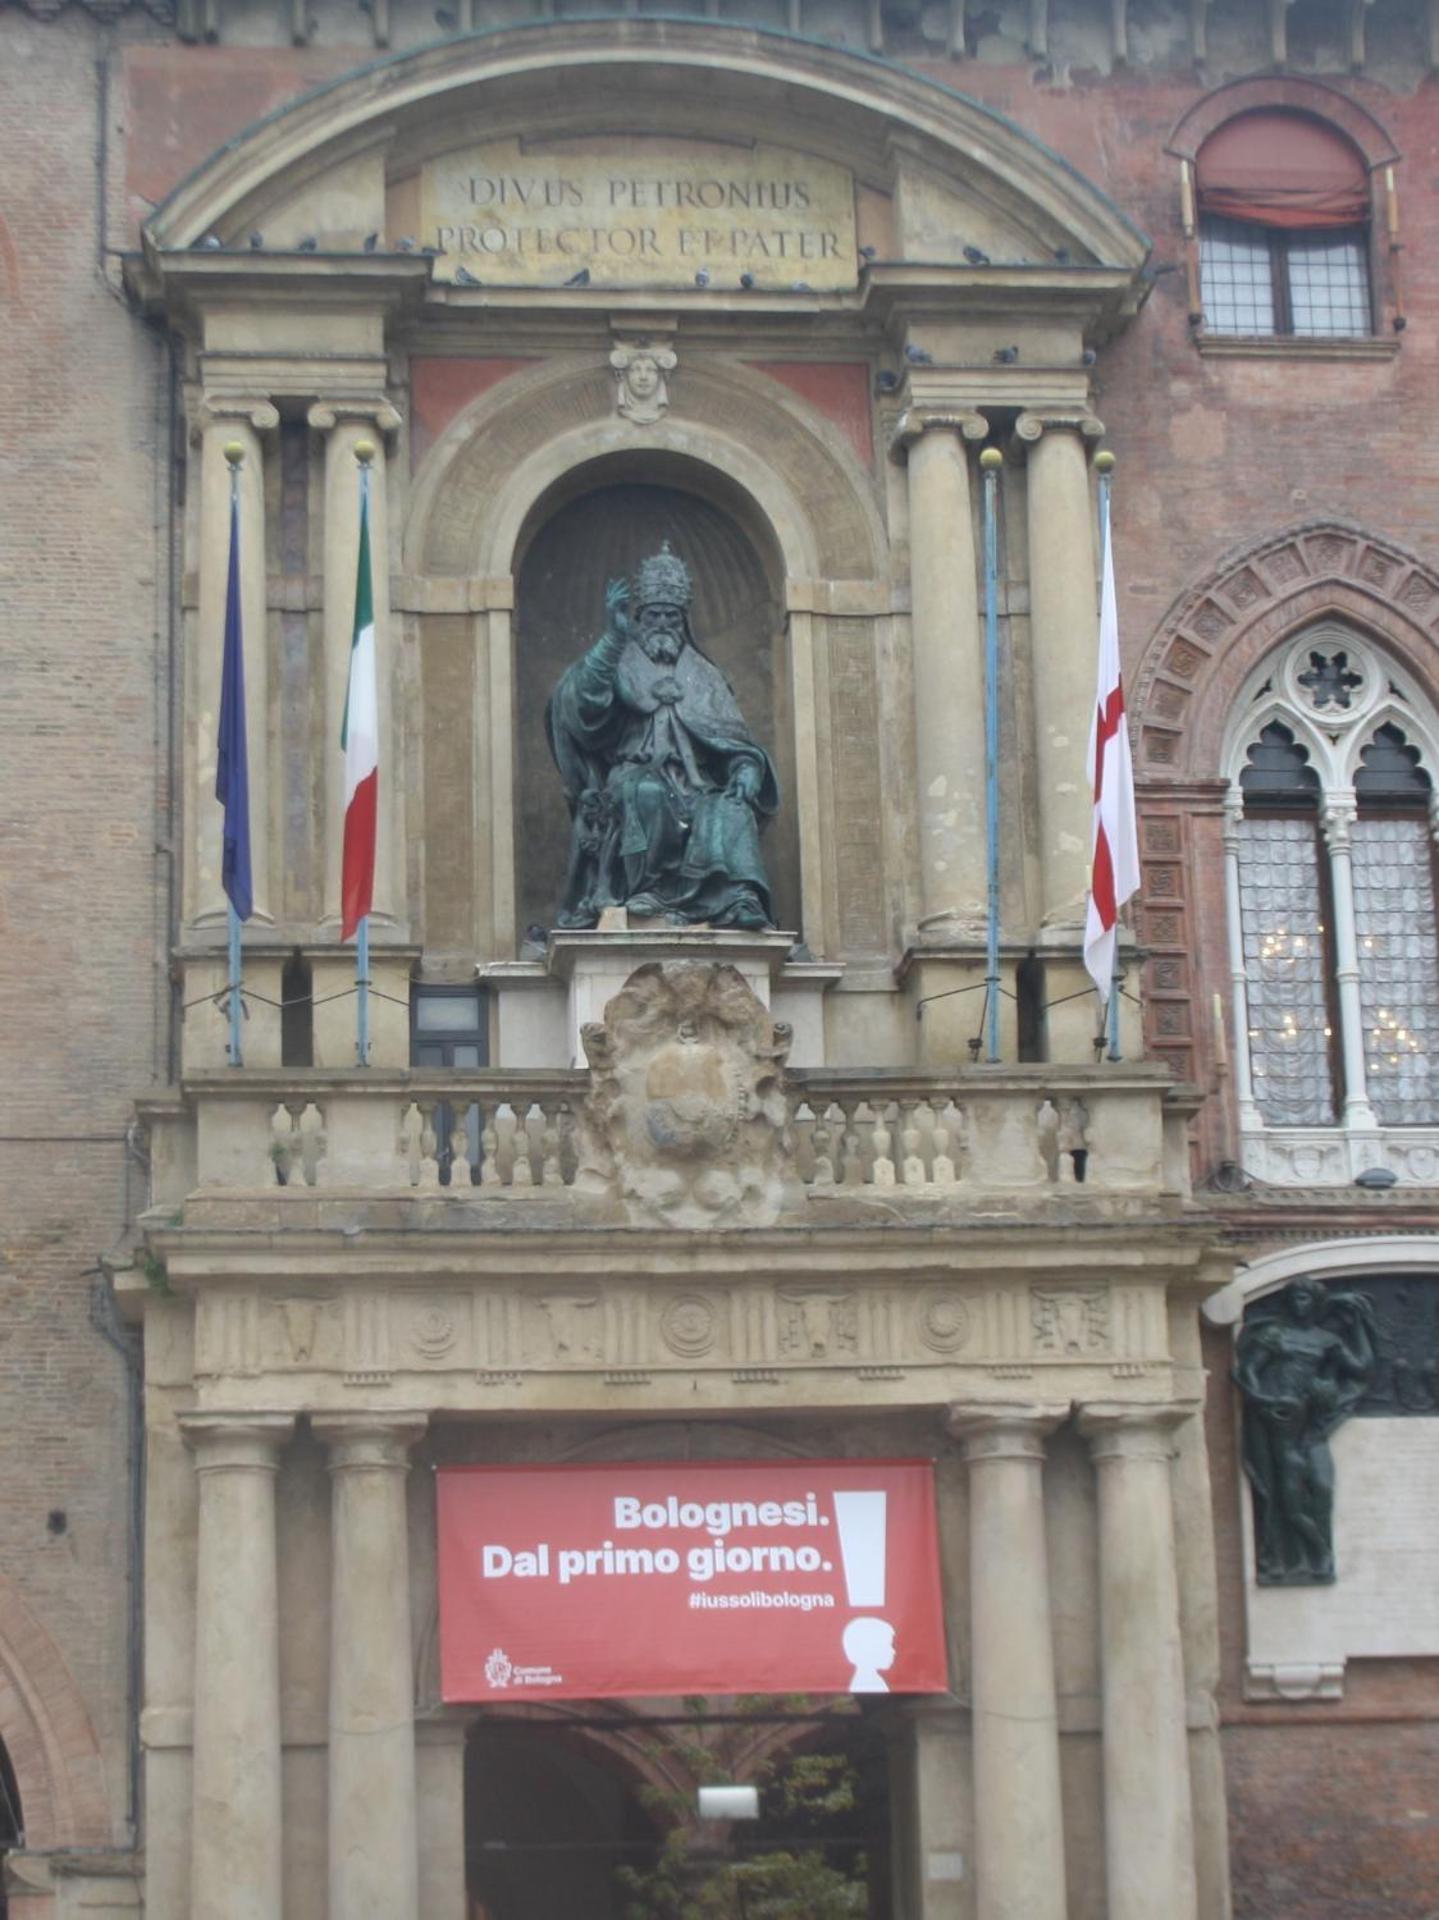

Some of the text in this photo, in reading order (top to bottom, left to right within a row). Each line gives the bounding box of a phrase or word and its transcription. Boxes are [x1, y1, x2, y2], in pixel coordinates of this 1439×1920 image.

[467, 175, 811, 210] DIVUS PETRONIUS
[437, 225, 845, 259] PROTECTOR ET PATER
[614, 1492, 830, 1535] Bolognesi.
[482, 1538, 833, 1584] Dal primo giorno.
[688, 1590, 836, 1612] #iussolibologna
